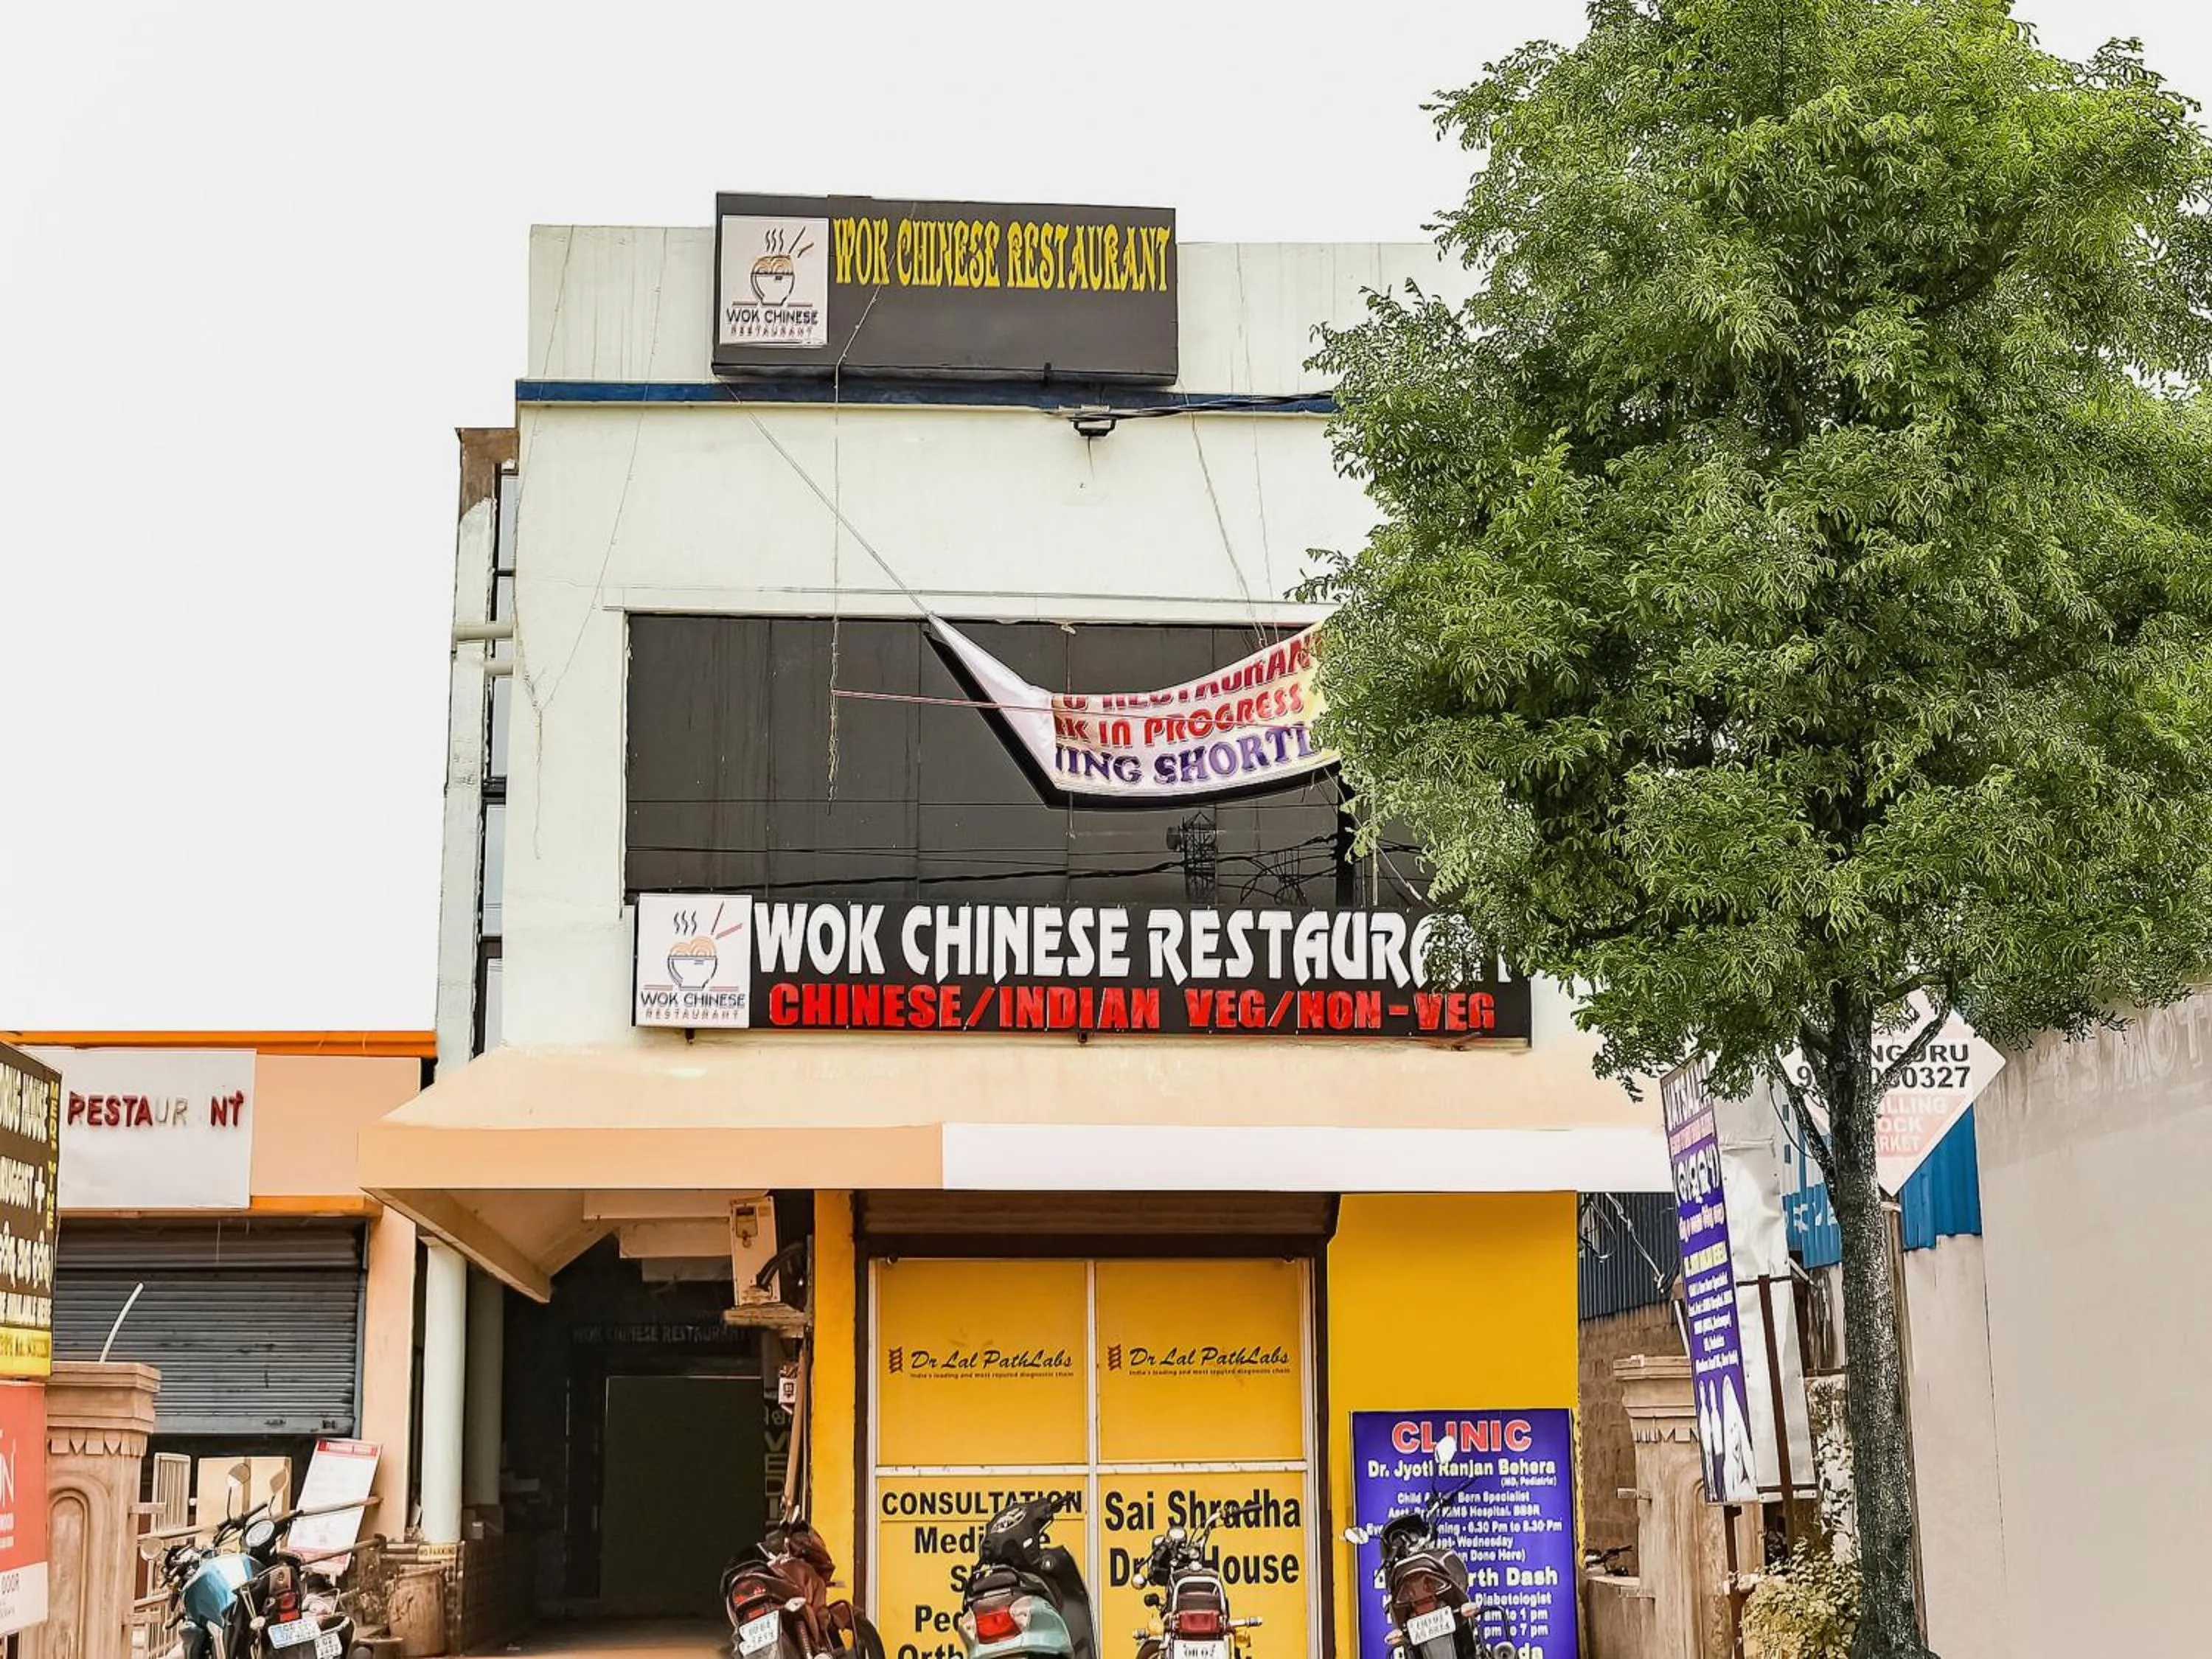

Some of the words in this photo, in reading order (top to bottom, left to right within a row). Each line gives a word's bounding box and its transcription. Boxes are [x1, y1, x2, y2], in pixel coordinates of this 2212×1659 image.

[833, 218, 890, 286] WOK
[895, 218, 1001, 288] CHINESE
[1006, 221, 1171, 292] RESTAURANT
[726, 308, 759, 323] WOK
[764, 309, 818, 324] CHINESE
[1099, 720, 1133, 748] IN
[1144, 682, 1304, 748] PROGRESS
[1154, 721, 1321, 785] SHORTL
[754, 902, 885, 975] WOK
[902, 904, 1130, 984] CHINESE
[1147, 908, 1513, 990] RESTAURAN
[641, 992, 678, 1006] WOK
[684, 992, 745, 1008] CHINESE
[769, 983, 1160, 1030] CHINESE/INDIAN
[1184, 988, 1495, 1031] VEG/NON-VEG
[645, 1009, 738, 1020] RESTAURANT
[911, 1351, 936, 1368] Dr
[942, 1351, 978, 1368] Lal
[984, 1349, 1074, 1368] PathLabs
[1130, 1348, 1156, 1366] Dr
[1159, 1348, 1196, 1366] Lal
[1201, 1346, 1289, 1366] PathLabs
[1391, 1419, 1532, 1454] CLINIC
[1368, 1460, 1390, 1478] Dr.
[1394, 1460, 1433, 1481] Jyoti
[1439, 1460, 1493, 1478] Ranjan
[1105, 1490, 1154, 1531] Sai
[1167, 1489, 1301, 1530] Shradha
[914, 1526, 1051, 1554] Medie
[1203, 1545, 1299, 1585] House
[1506, 1565, 1558, 1586] Dash
[1530, 1609, 1548, 1623] pm
[1520, 1623, 1527, 1636] 7
[1530, 1624, 1548, 1638] pm
